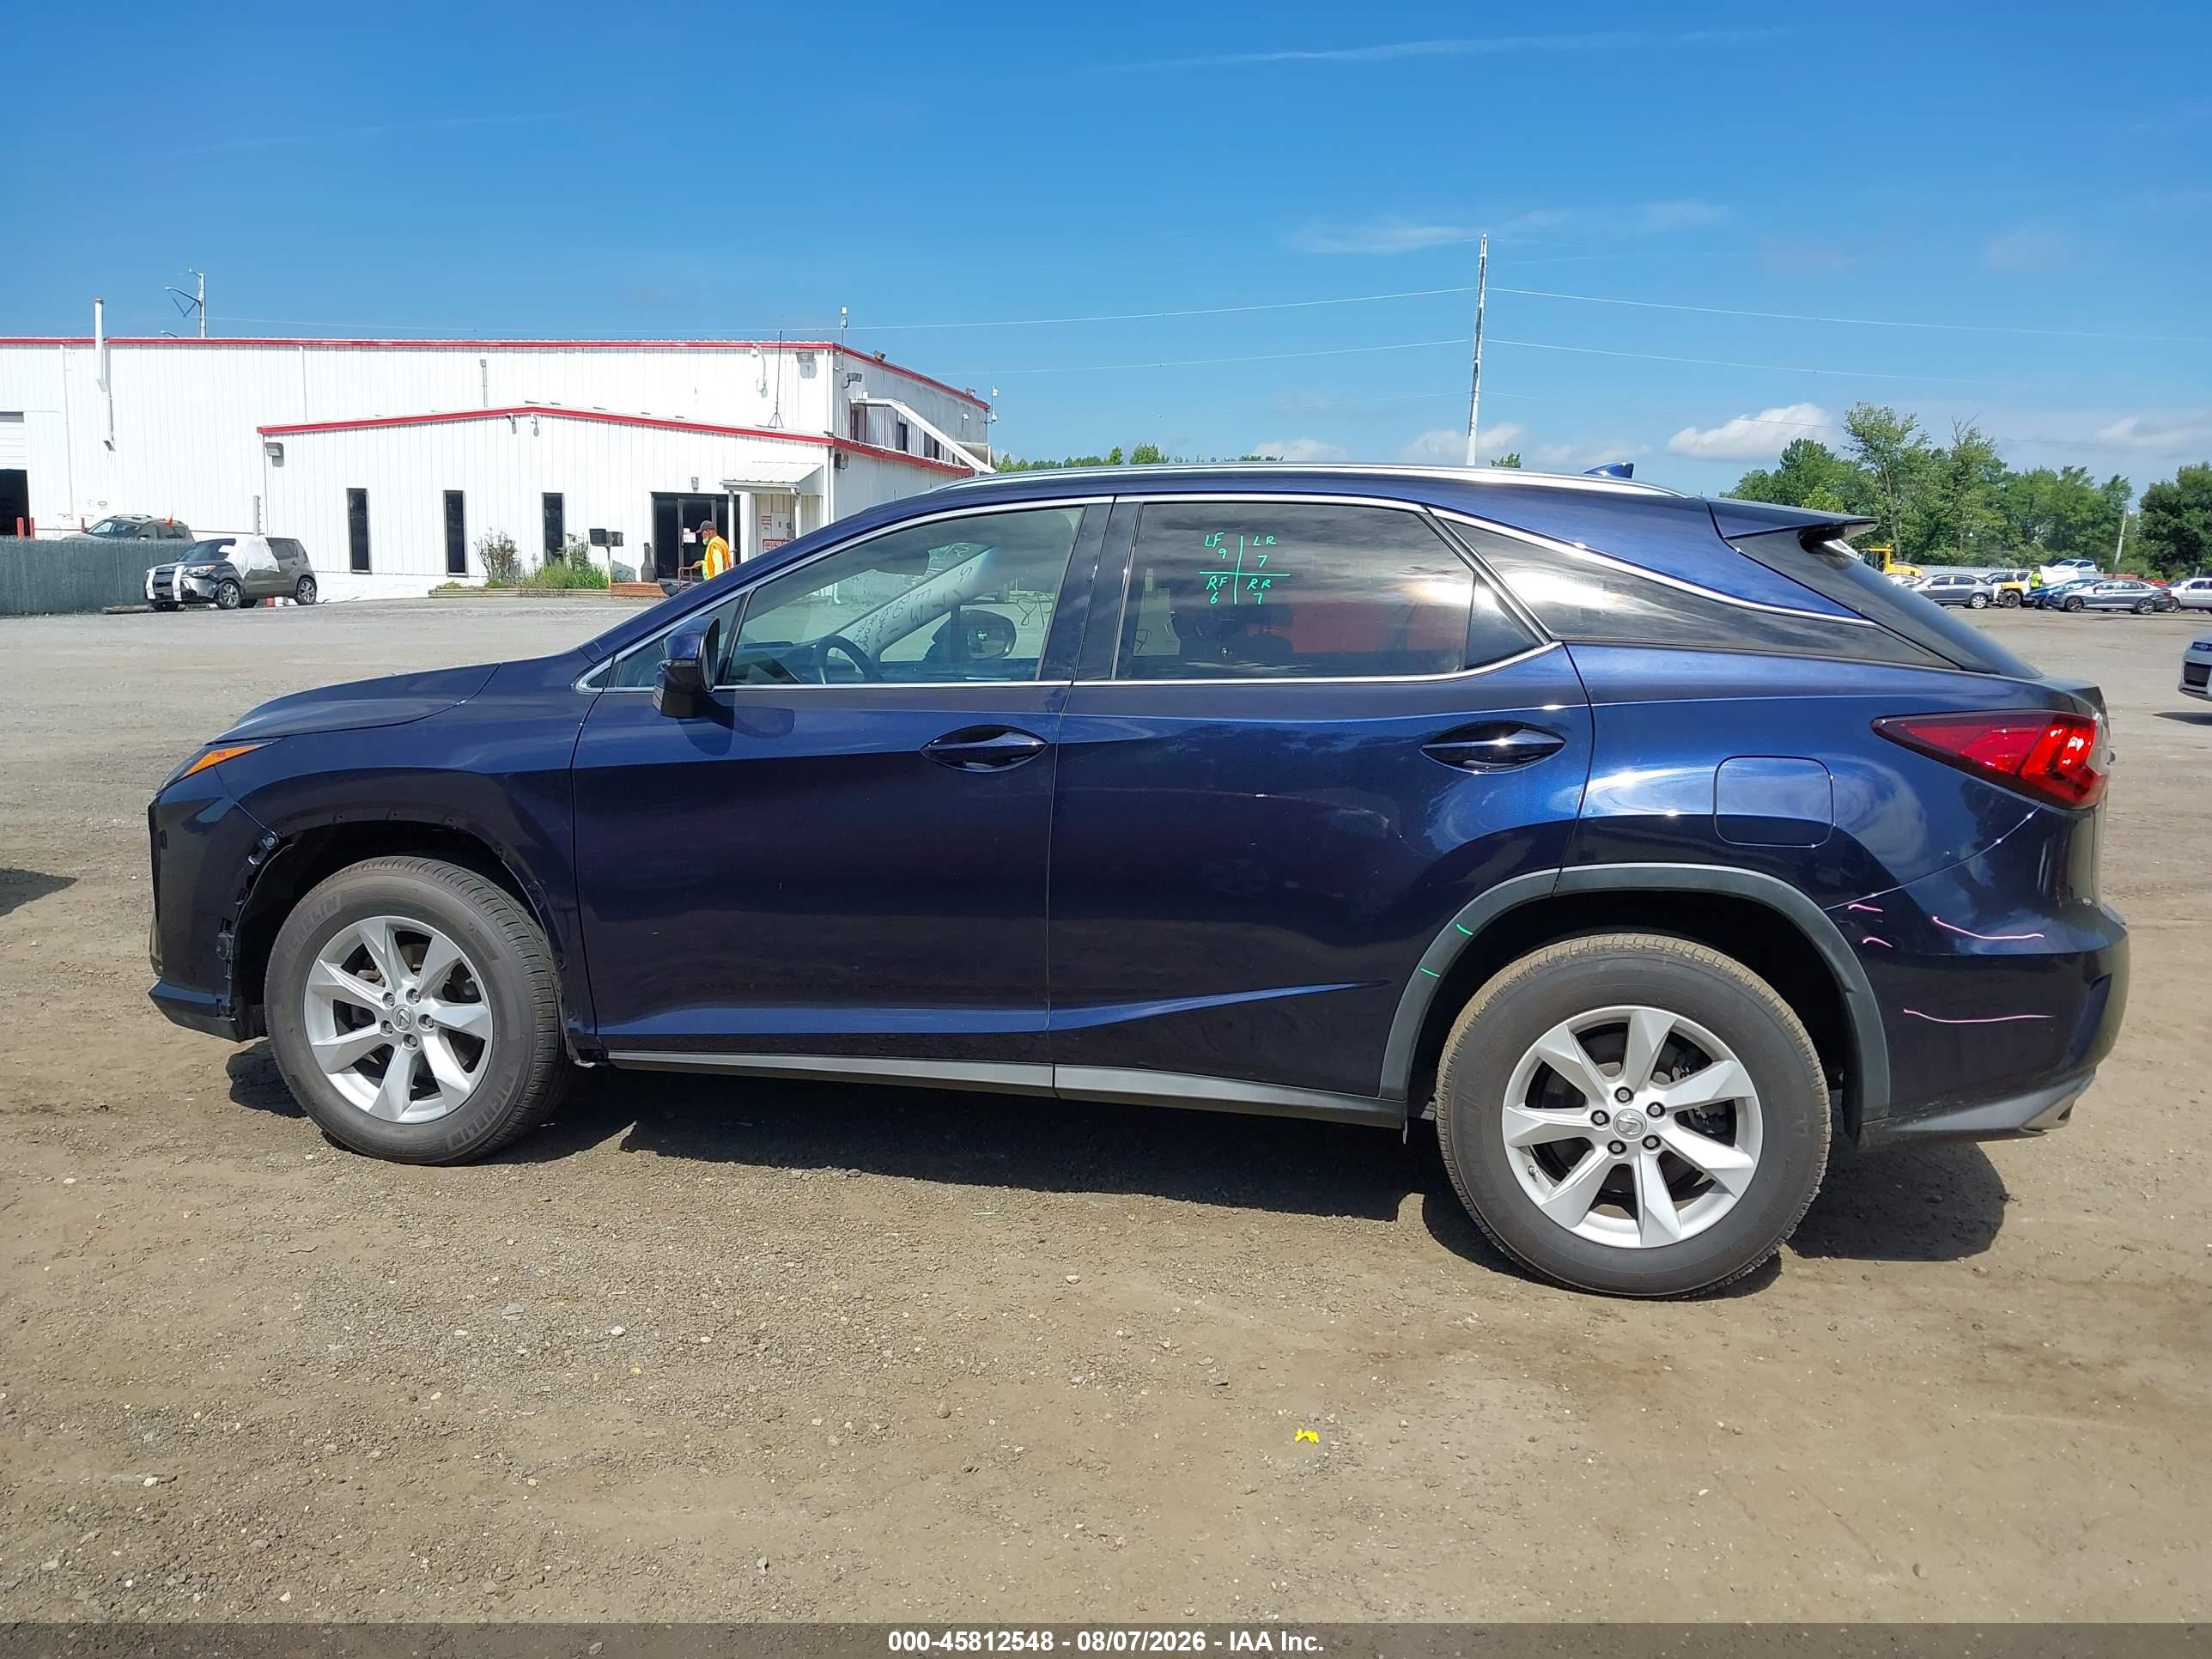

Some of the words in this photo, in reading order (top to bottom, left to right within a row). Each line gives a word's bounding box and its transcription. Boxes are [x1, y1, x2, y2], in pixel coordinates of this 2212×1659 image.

[1204, 532, 1224, 548] LF
[1218, 548, 1227, 559] 9
[1257, 555, 1268, 568] 7
[1206, 575, 1228, 591] RF
[1247, 578, 1271, 591] RR
[1210, 592, 1218, 605] 6
[1253, 592, 1263, 605] 7
